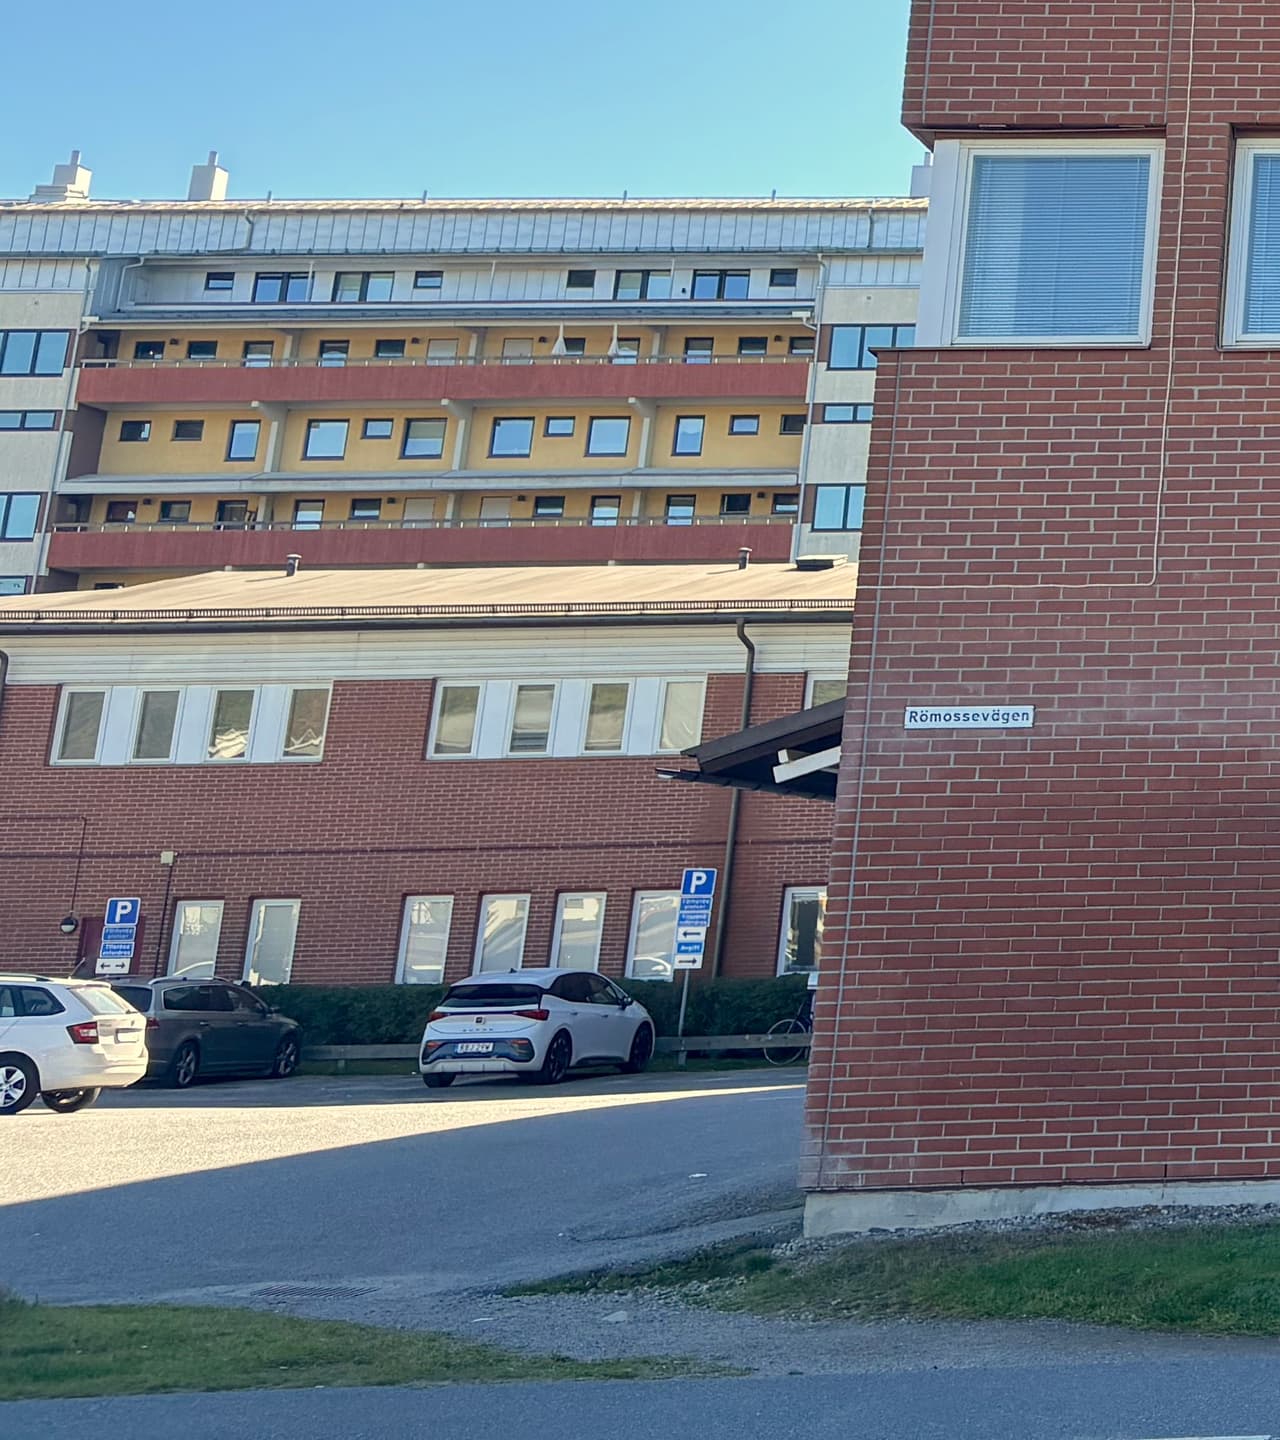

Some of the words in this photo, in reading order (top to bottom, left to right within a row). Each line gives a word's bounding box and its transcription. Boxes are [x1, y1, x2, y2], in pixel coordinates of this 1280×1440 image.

[908, 709, 1030, 724] Römossevägen
[690, 871, 707, 893] P
[115, 901, 132, 922] P
